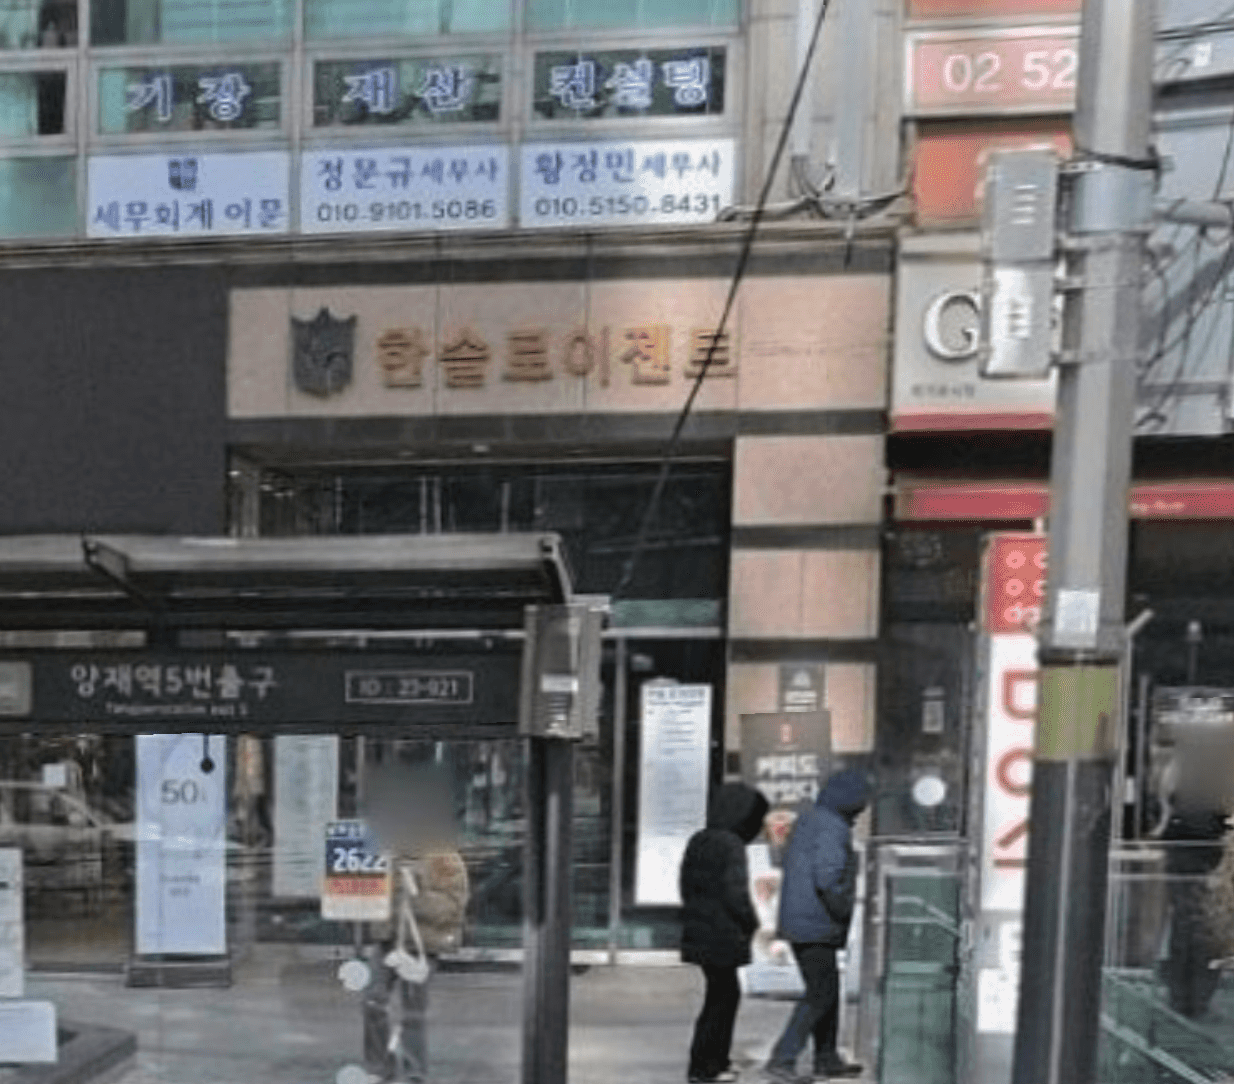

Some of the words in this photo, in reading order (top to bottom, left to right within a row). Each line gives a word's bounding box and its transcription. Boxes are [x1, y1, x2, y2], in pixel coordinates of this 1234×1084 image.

[342, 65, 474, 113] 재산
[549, 56, 710, 110] 컨설팅
[943, 52, 1002, 94] 02
